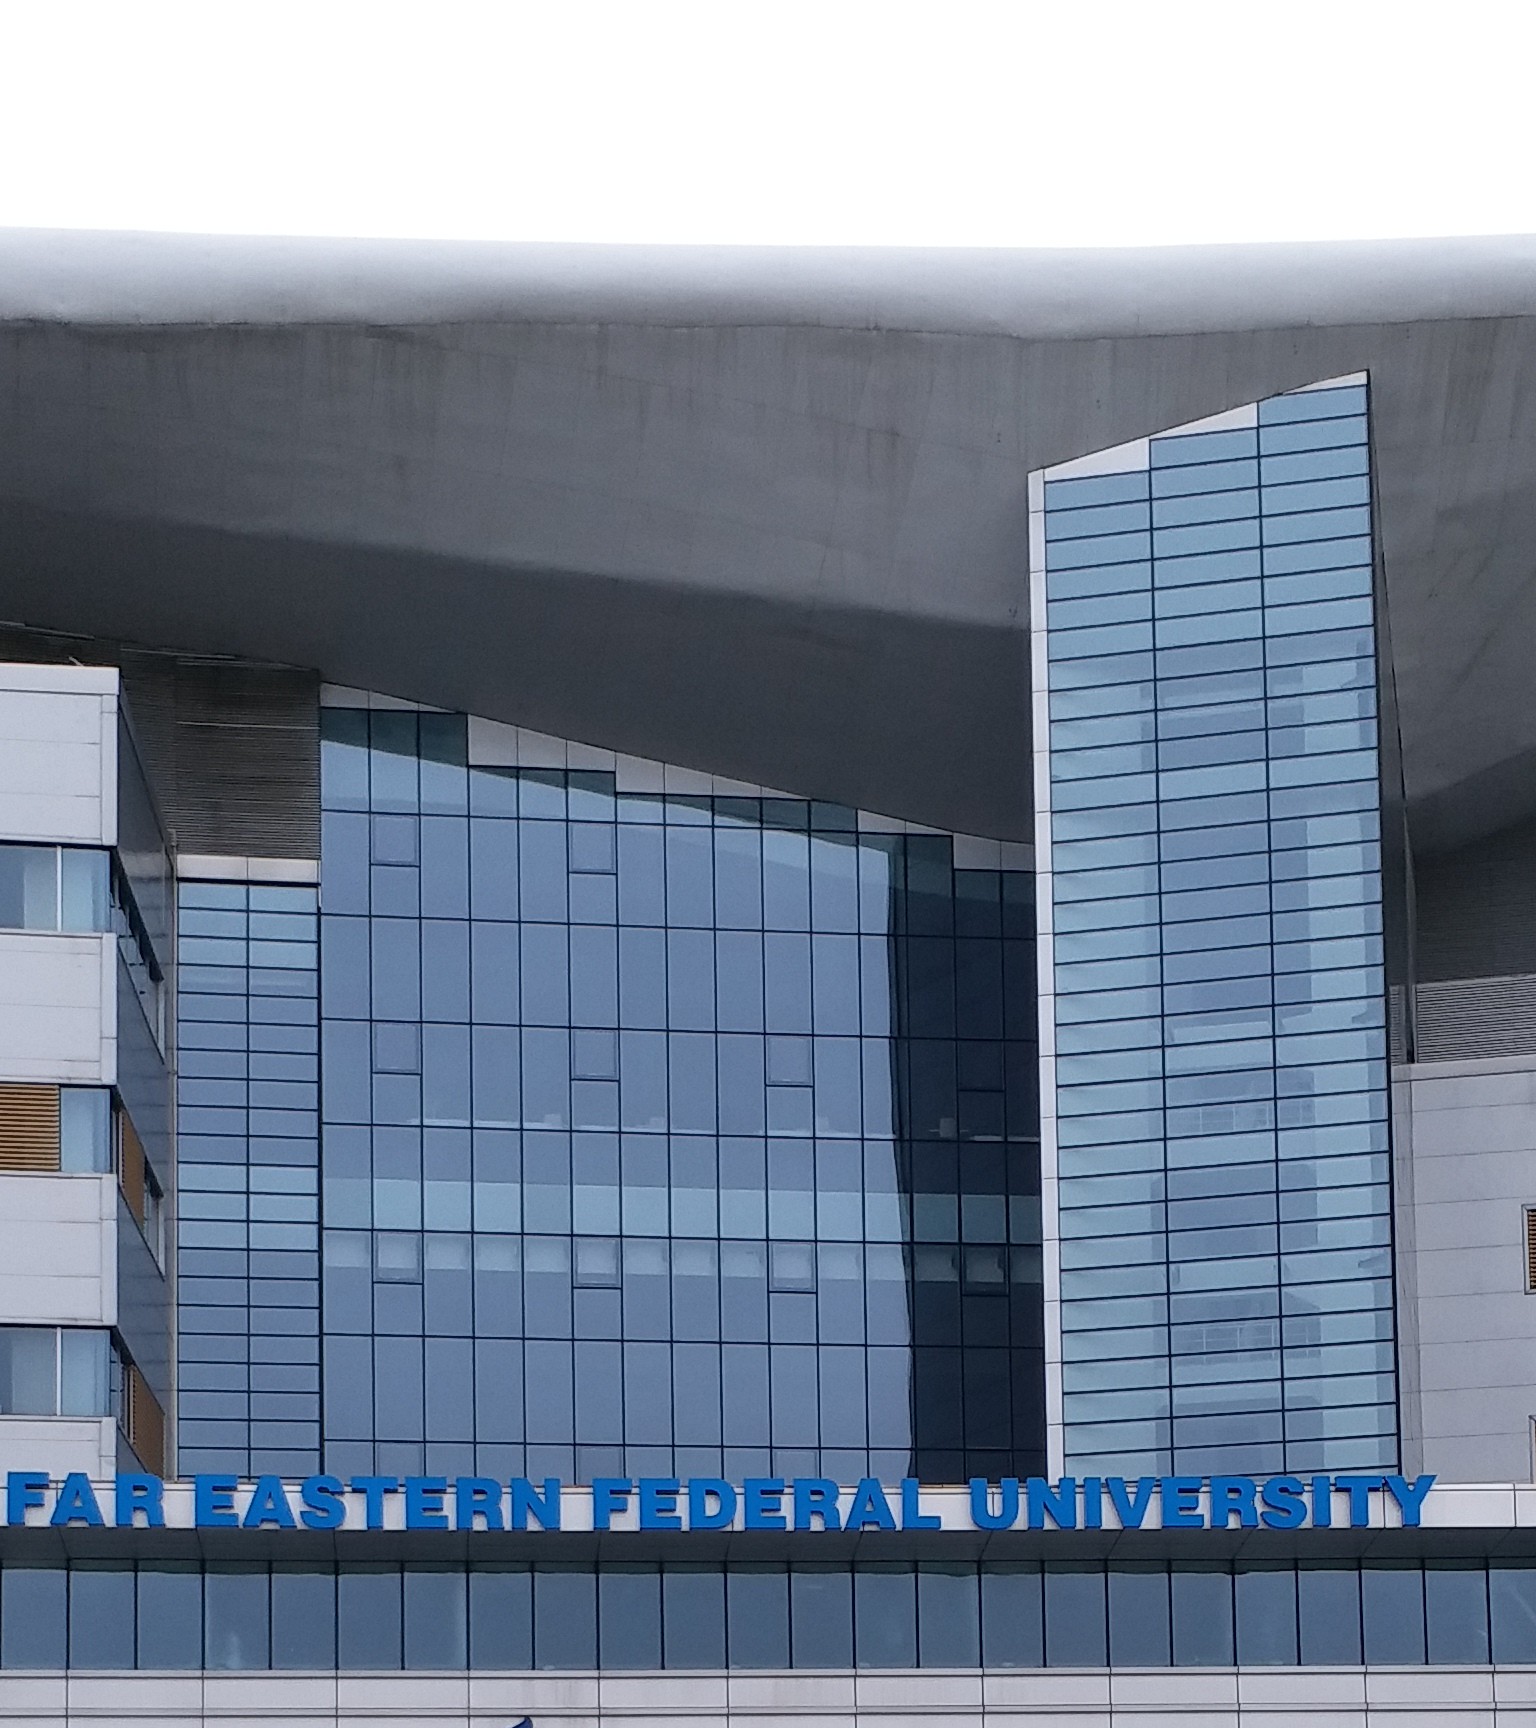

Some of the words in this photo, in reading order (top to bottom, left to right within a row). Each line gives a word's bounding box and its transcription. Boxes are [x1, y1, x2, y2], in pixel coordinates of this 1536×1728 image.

[7, 1471, 164, 1527] FAR
[195, 1474, 561, 1531] EASTERN
[593, 1477, 941, 1531] FEDERAL
[969, 1475, 1438, 1530] UNIVERSITY
